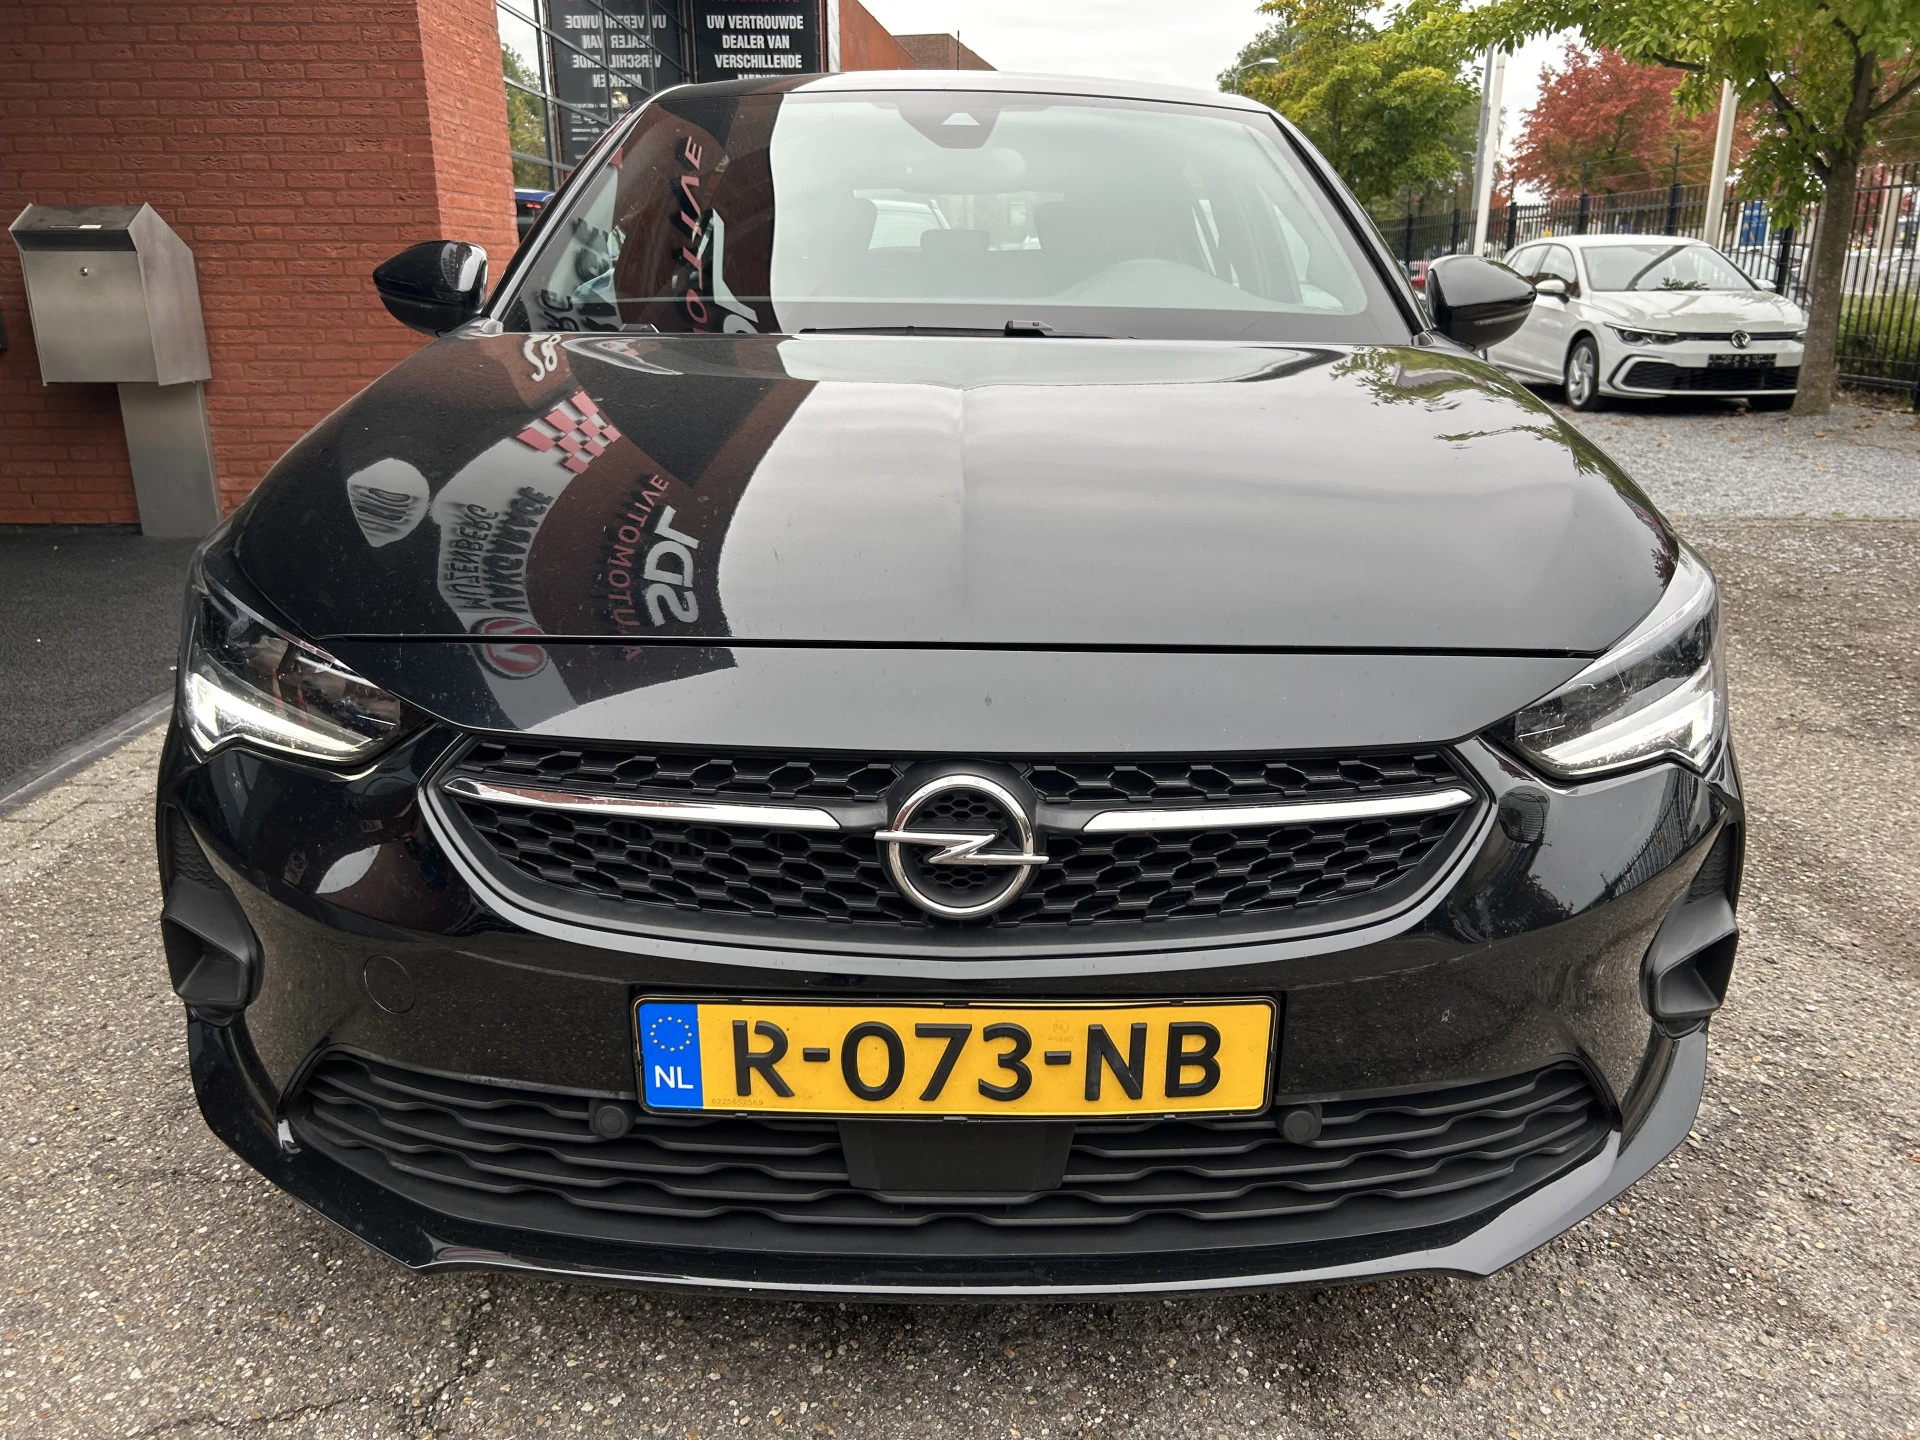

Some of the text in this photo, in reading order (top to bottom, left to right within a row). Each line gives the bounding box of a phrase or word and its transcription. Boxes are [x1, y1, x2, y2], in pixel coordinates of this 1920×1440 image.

[706, 15, 804, 30] UW VERTROUWDE
[722, 34, 790, 49] DEALER VAN
[714, 54, 803, 69] VERSCHILLENDE
[732, 1019, 1221, 1101] R-073-NB
[654, 1065, 694, 1090] NL
